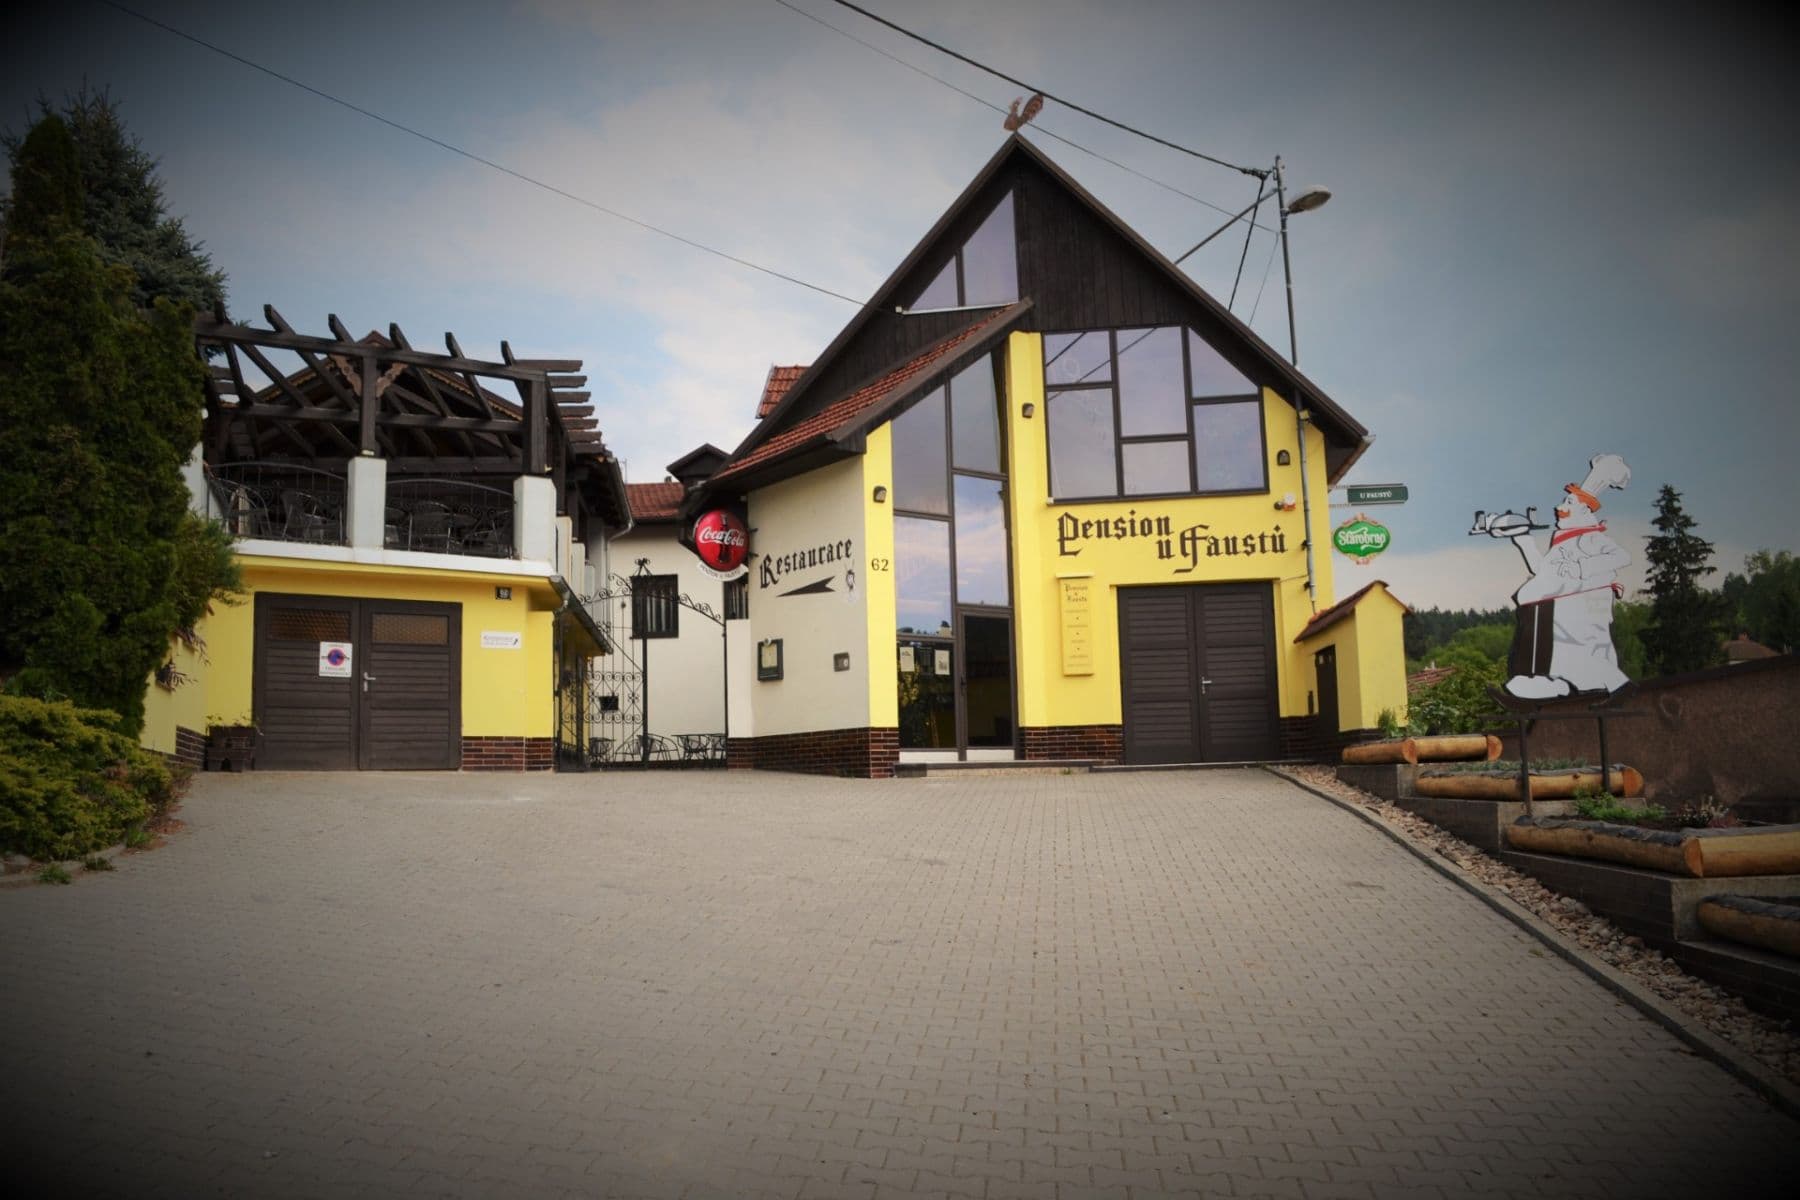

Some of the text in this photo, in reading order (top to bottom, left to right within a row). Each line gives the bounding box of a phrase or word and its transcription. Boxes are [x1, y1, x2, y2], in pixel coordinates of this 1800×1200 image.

[1057, 509, 1174, 557] Pension
[1156, 538, 1175, 560] u
[760, 538, 853, 590] Restaurace
[871, 558, 889, 572] 62
